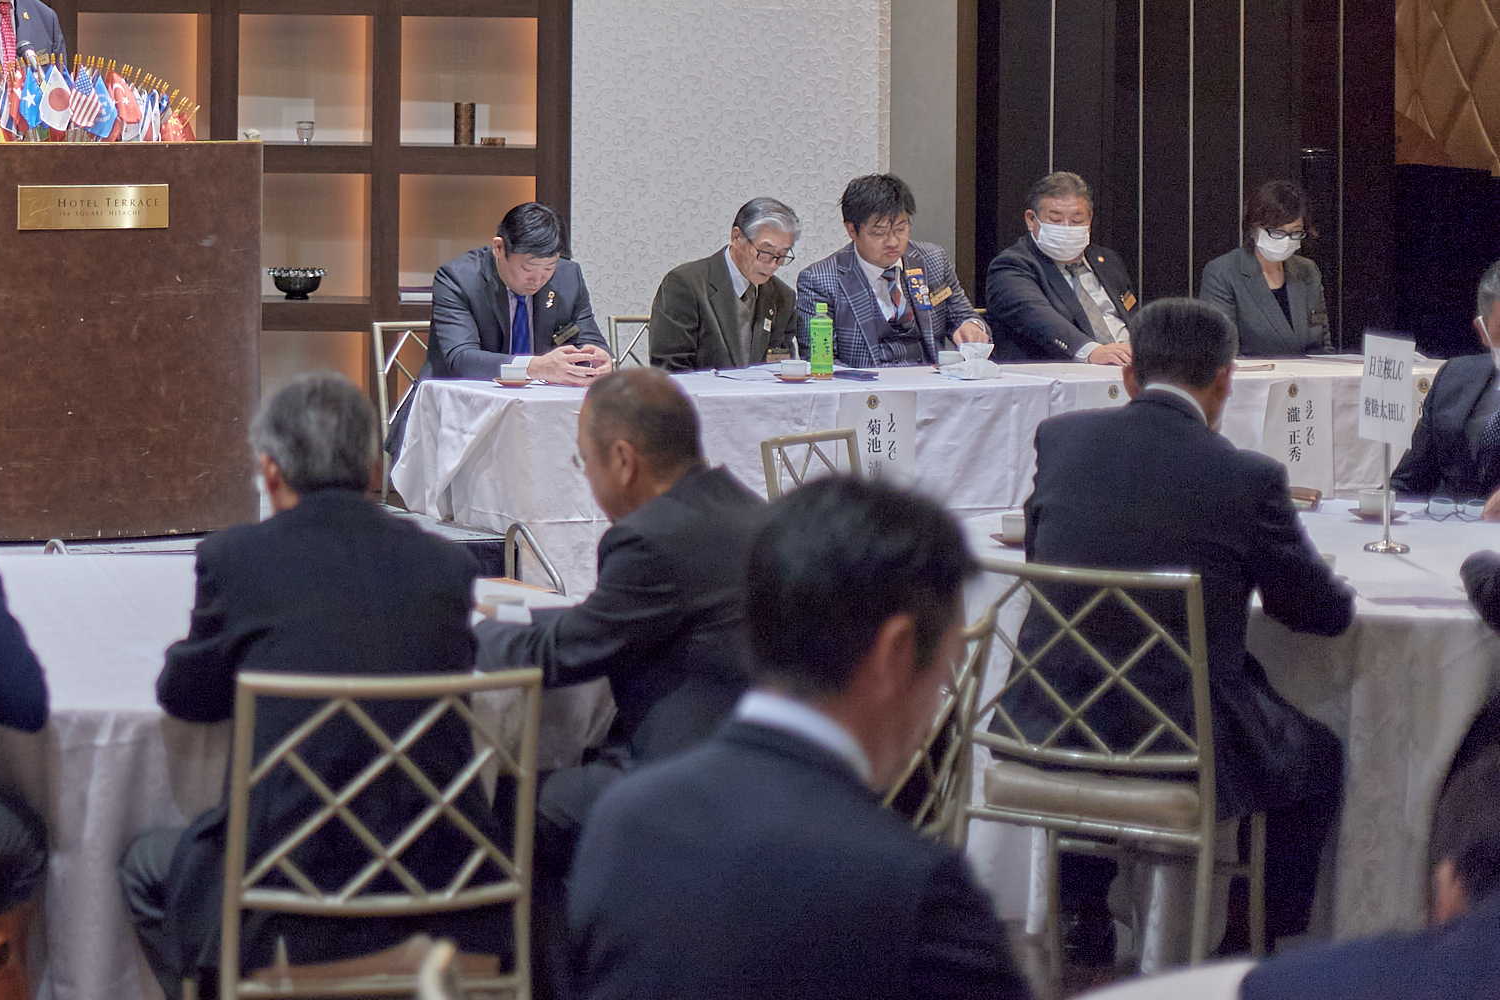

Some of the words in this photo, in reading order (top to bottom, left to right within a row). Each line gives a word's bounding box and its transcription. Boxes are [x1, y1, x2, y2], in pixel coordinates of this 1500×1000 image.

[57, 198, 99, 208] HOTEL
[105, 197, 160, 208] TERRACE
[1369, 355, 1405, 381] 日立桜LC
[1364, 396, 1406, 423] 常陸太田LC
[866, 418, 882, 454] 菊池
[1287, 429, 1302, 463] 正秀
